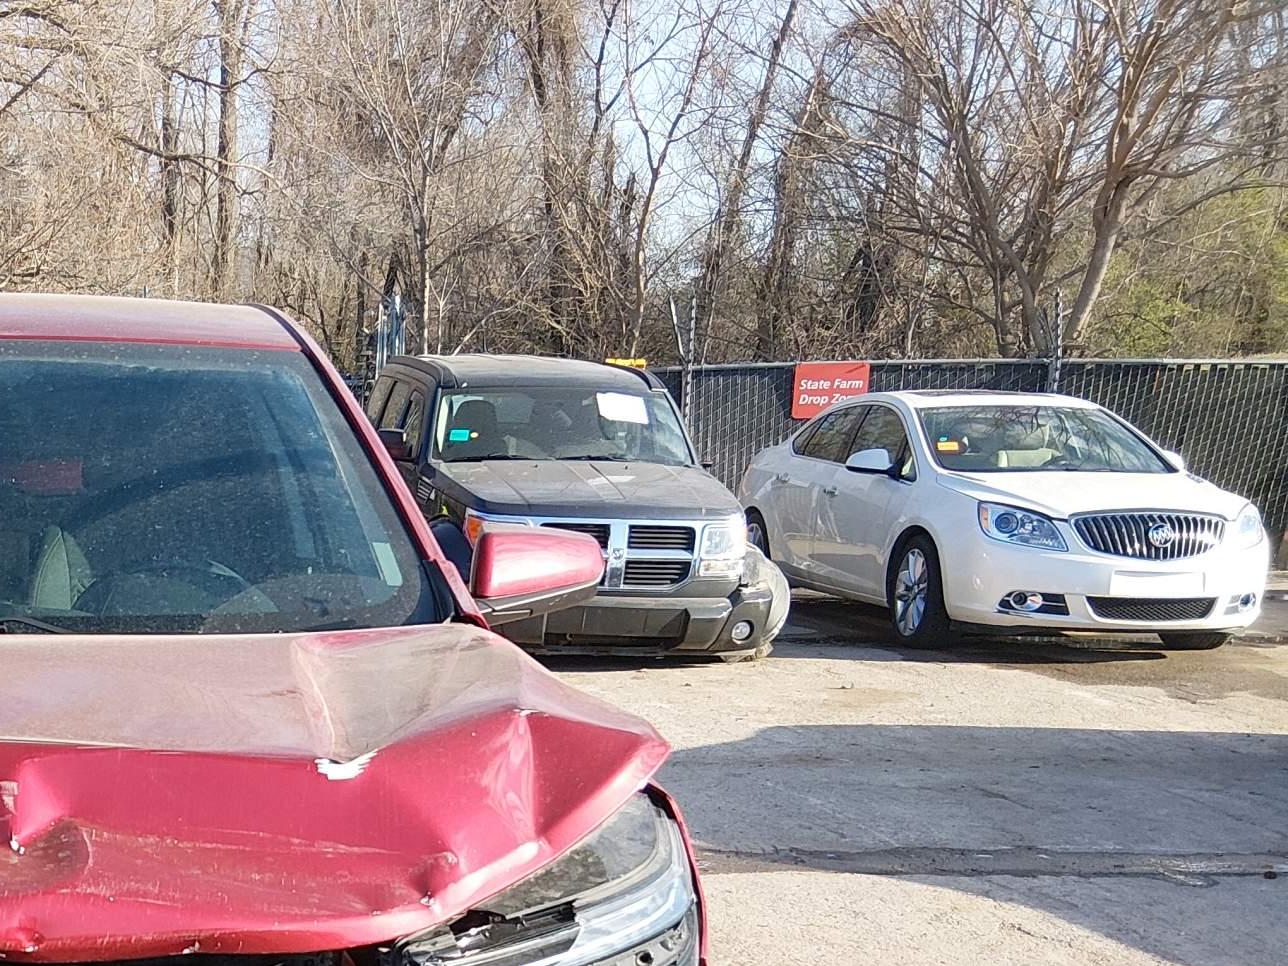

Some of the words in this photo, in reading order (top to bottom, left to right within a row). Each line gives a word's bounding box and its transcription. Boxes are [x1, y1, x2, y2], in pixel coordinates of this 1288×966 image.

[799, 379, 831, 390] State
[833, 378, 863, 389] Farm
[799, 394, 829, 406] Drop
[831, 393, 855, 404] Zo
